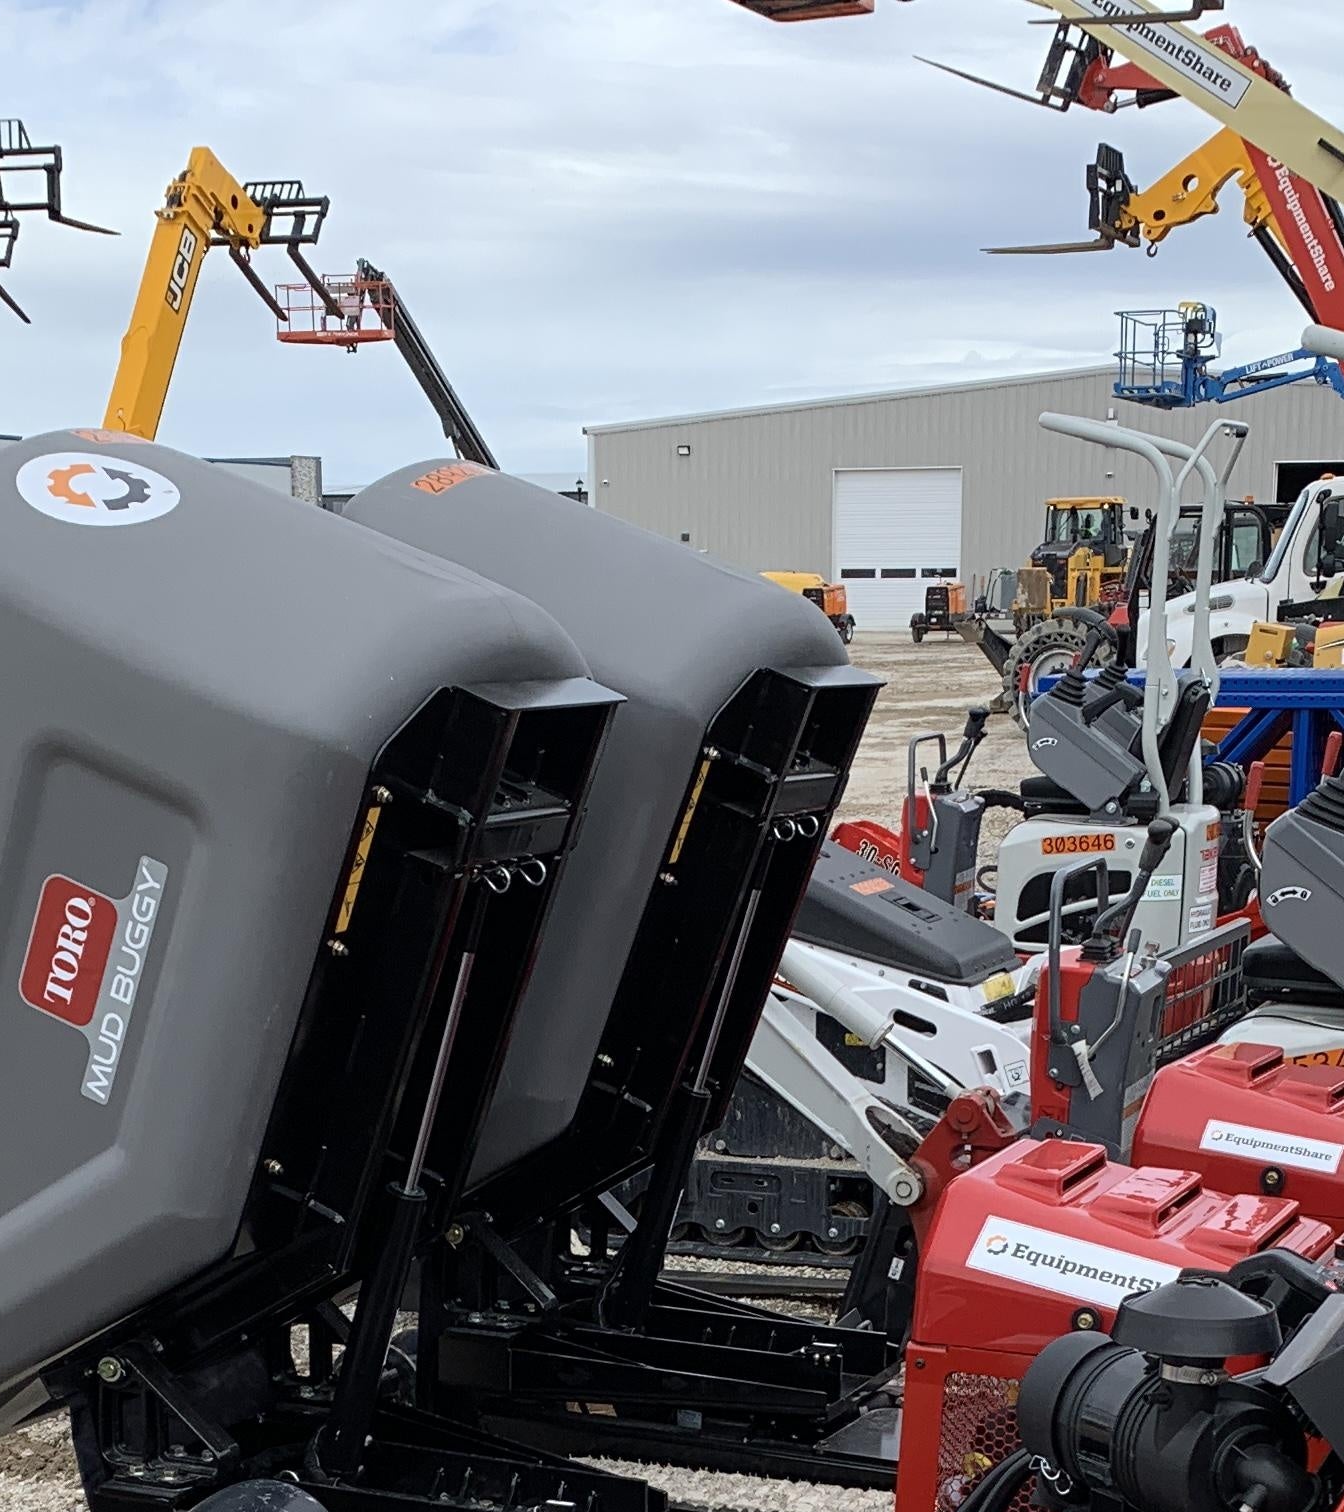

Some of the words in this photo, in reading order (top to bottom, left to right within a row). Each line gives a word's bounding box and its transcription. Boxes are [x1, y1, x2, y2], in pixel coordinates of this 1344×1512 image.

[169, 227, 197, 311] JCB
[1275, 164, 1336, 293] EquipmentShare
[1042, 833, 1116, 855] 303646
[1150, 877, 1176, 887] DIESEL
[44, 896, 93, 1005] TORO
[86, 1011, 125, 1100] MUD
[110, 866, 162, 1005] BUGGY
[1224, 1132, 1334, 1163] EquipmentShare
